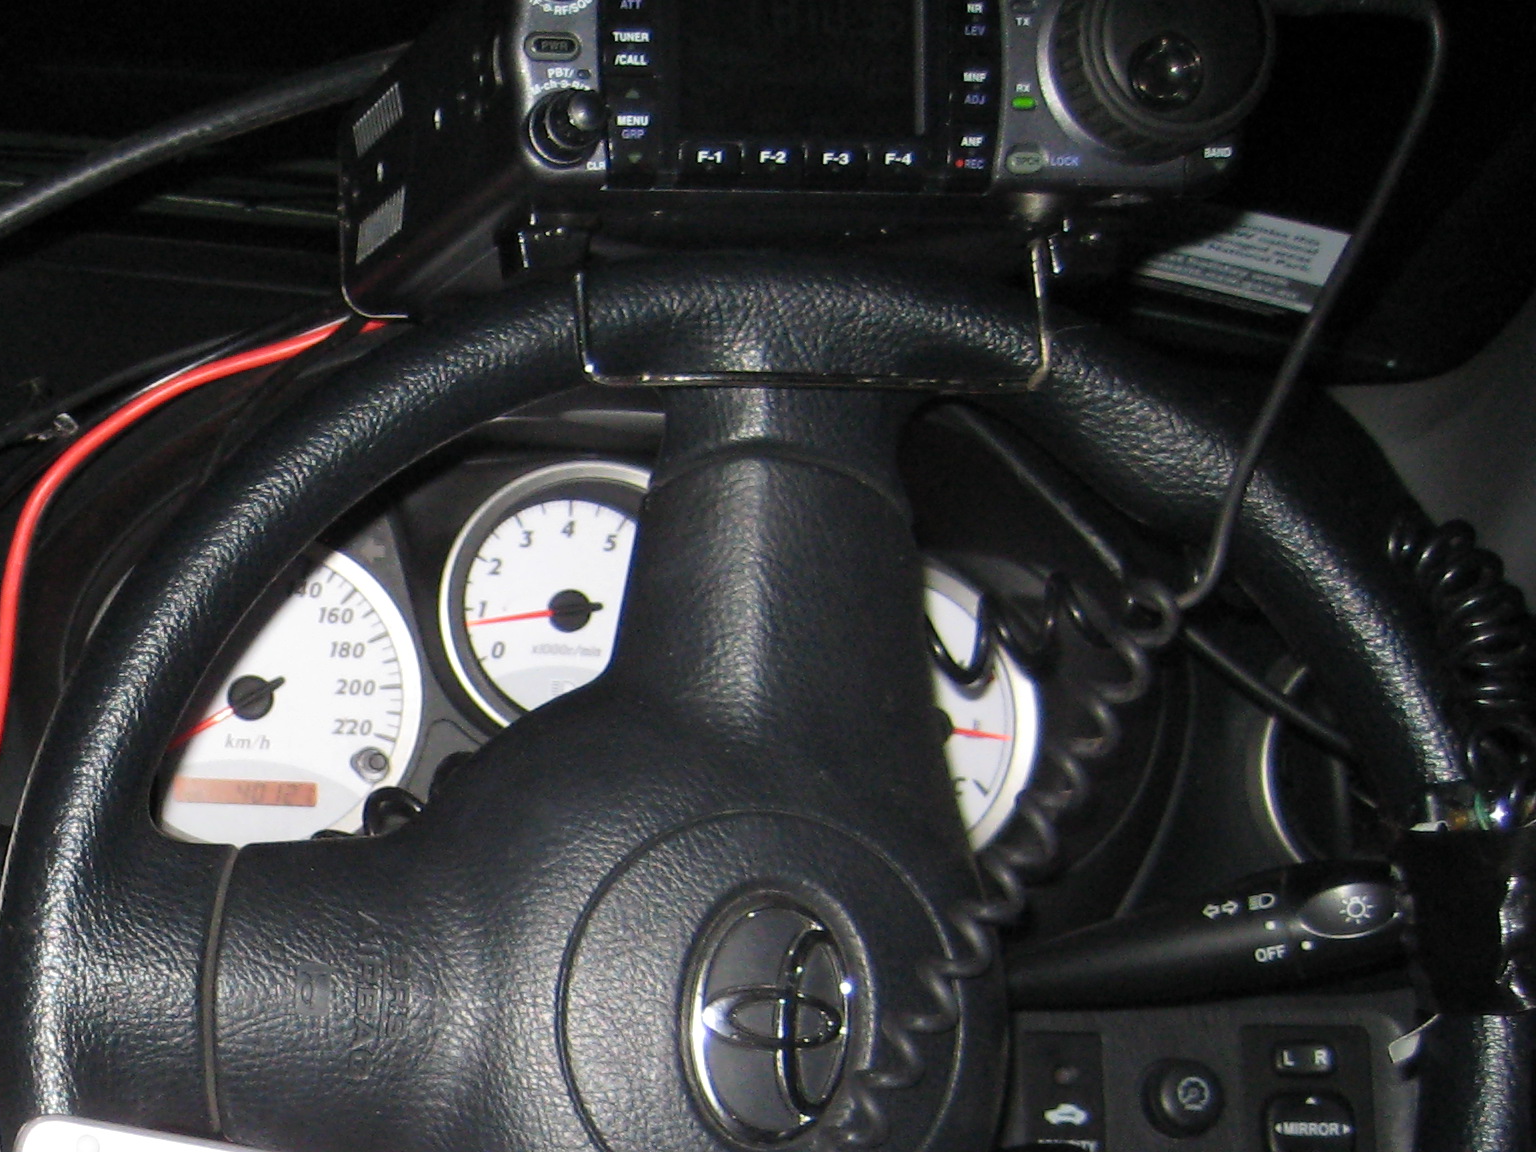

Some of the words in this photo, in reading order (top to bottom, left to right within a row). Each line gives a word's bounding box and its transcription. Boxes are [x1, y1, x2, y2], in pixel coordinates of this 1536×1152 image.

[1016, 16, 1031, 27] TX
[613, 31, 650, 43] TUNER
[964, 25, 986, 36] LEV
[615, 55, 648, 66] /CALL
[1016, 83, 1031, 93] RX
[964, 94, 986, 105] ADJ
[617, 115, 650, 127] MENU
[621, 128, 645, 140] GRP
[960, 136, 983, 147] ANF
[696, 151, 723, 164] F-1
[759, 151, 787, 165] F-2
[822, 153, 850, 166] F-3
[884, 153, 913, 166] F-4
[1204, 147, 1232, 159] BAND
[965, 159, 985, 170] REC
[1050, 156, 1080, 167] LOCK
[561, 520, 575, 538] 4
[519, 530, 533, 548] 3
[603, 534, 617, 552] 5
[487, 558, 502, 576] 2
[478, 600, 487, 618] 1
[318, 607, 354, 625] 160
[329, 640, 366, 659] 180
[491, 641, 506, 659] 0
[334, 678, 376, 696] 200
[331, 719, 373, 736] 220
[224, 735, 271, 750] km/h
[1254, 943, 1286, 962] OFF
[1283, 1049, 1294, 1064] L
[1314, 1050, 1327, 1064] R
[1283, 1121, 1340, 1137] MIRROR
